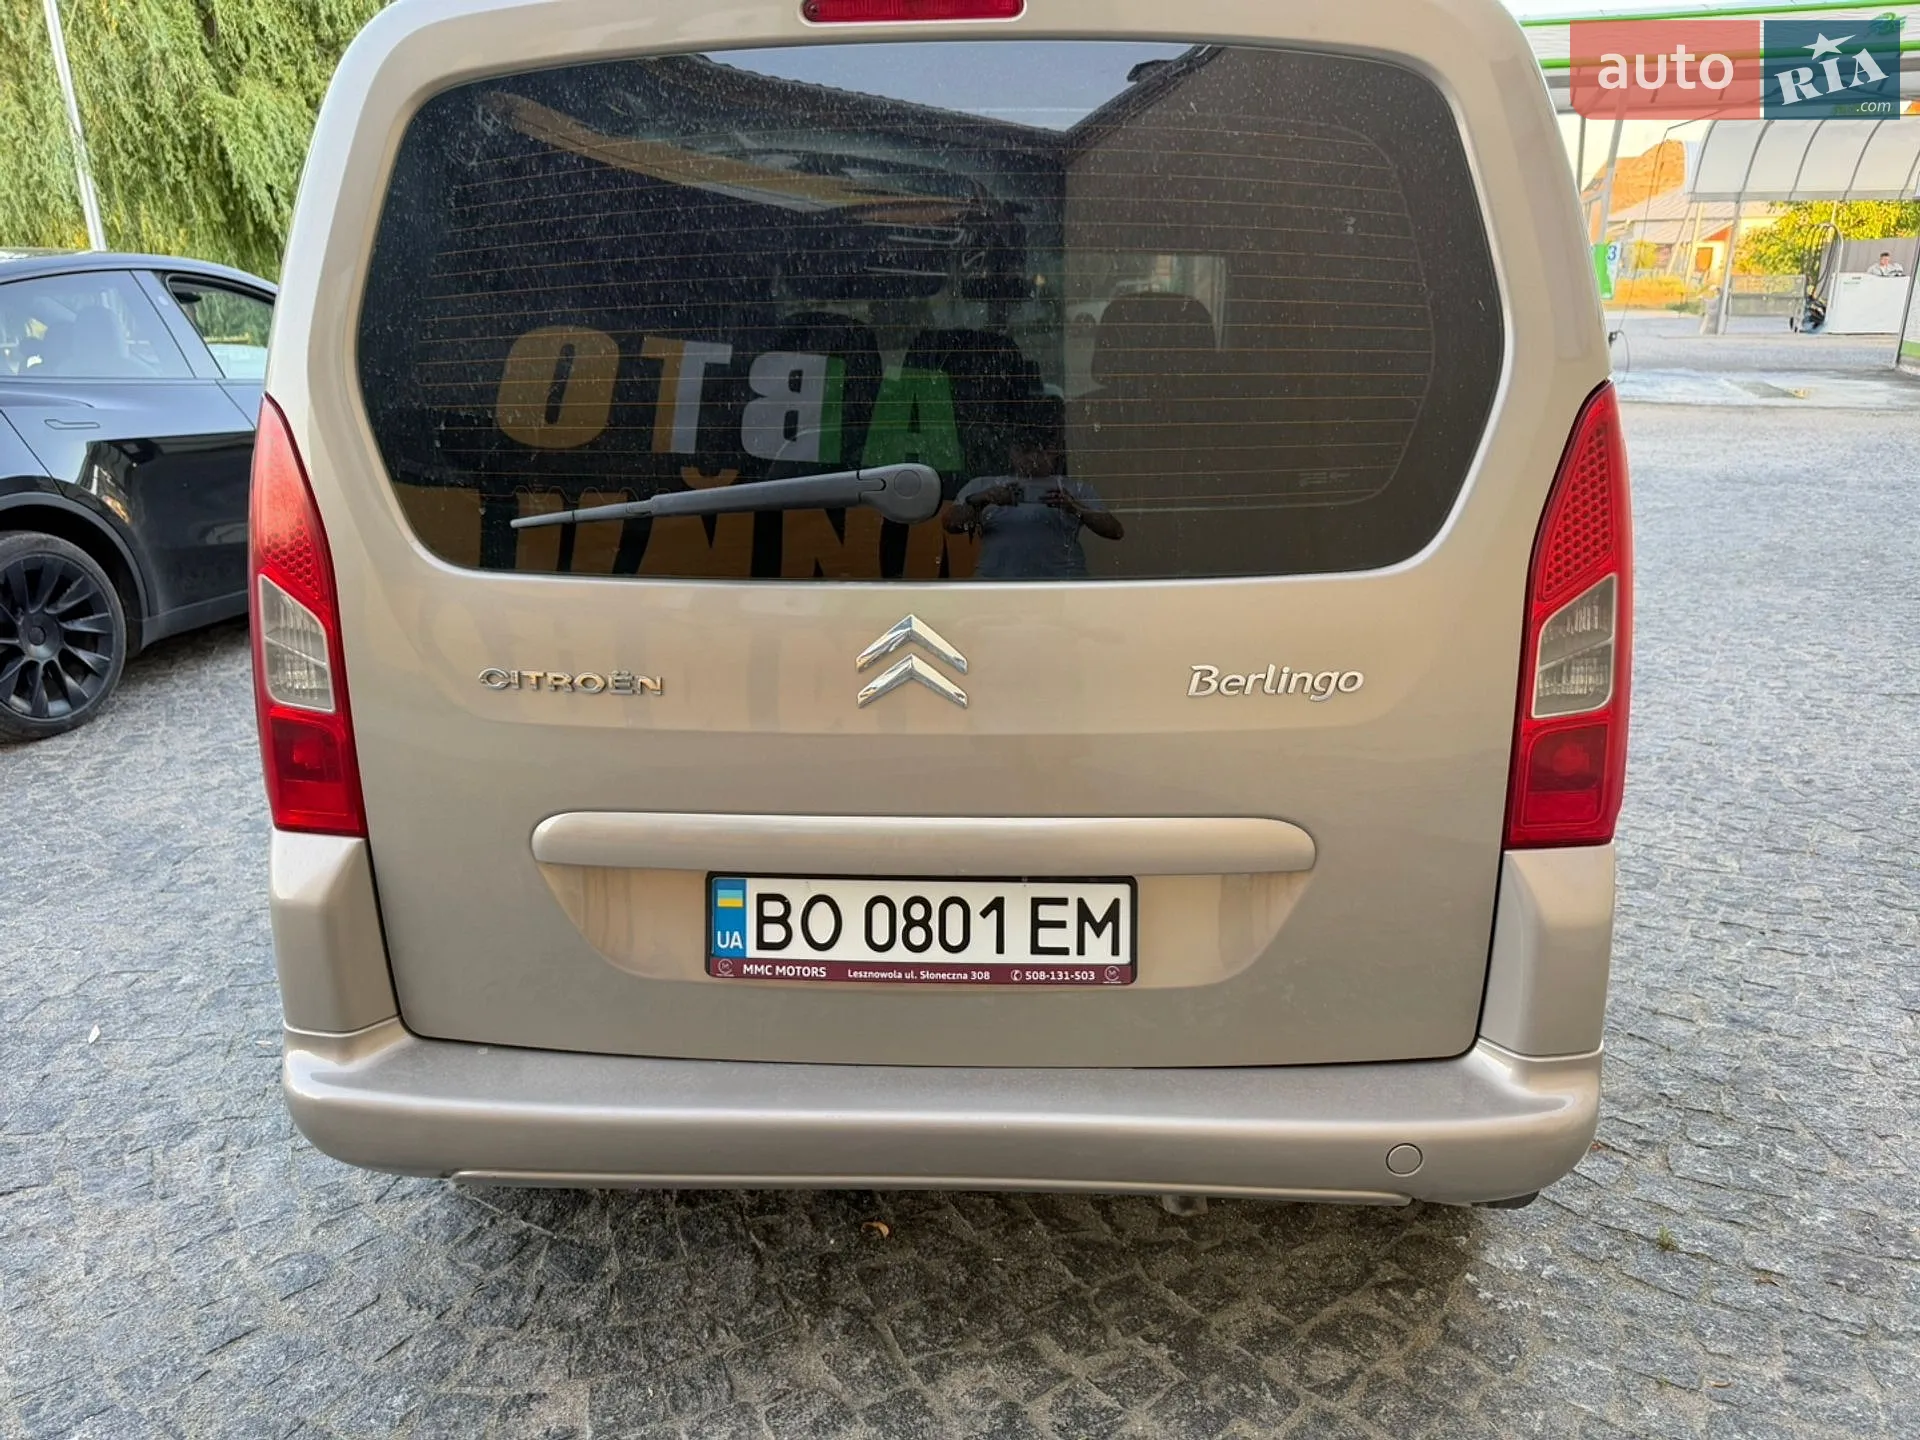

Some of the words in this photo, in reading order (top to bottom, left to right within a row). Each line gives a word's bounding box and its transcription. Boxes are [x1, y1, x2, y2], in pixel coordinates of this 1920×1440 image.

[478, 667, 664, 696] CITROËN
[1187, 663, 1364, 702] Berlingo
[756, 892, 842, 952] BO
[864, 895, 1005, 955] 0801
[1030, 897, 1120, 956] EM
[716, 931, 743, 949] UA
[743, 964, 772, 976] MMC
[775, 965, 827, 978] MOTORS
[847, 969, 902, 980] Lesznowola
[905, 970, 918, 980] ul.
[920, 970, 968, 981] Słoneczna
[971, 971, 991, 981] 308
[1025, 970, 1096, 982] 508-131-503
